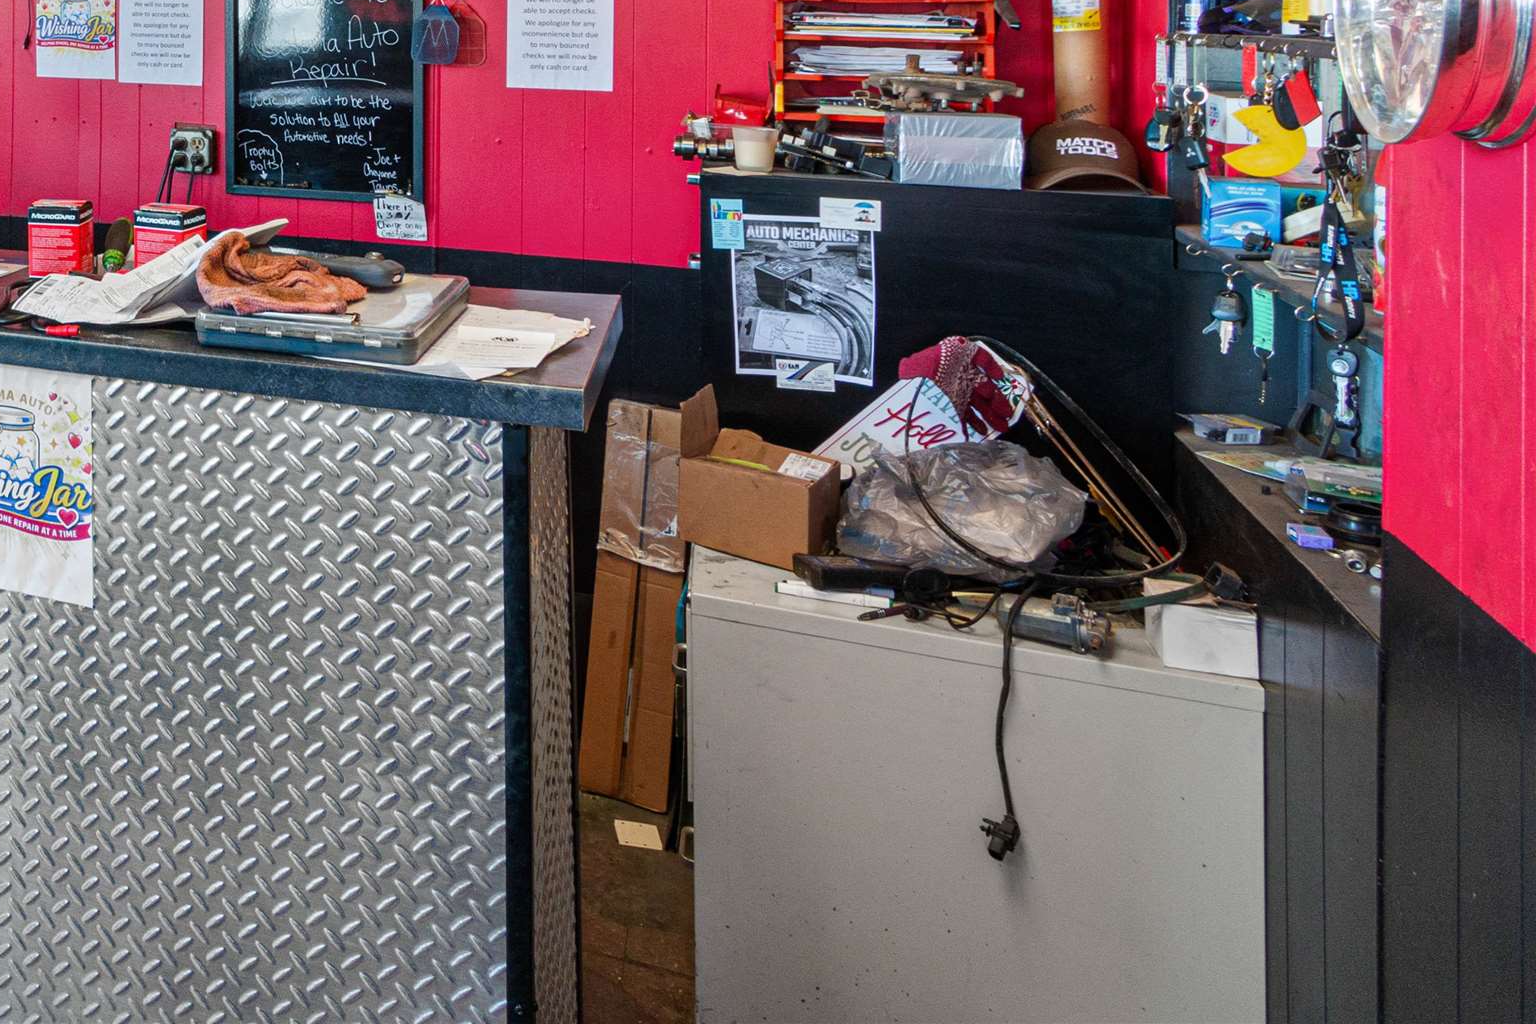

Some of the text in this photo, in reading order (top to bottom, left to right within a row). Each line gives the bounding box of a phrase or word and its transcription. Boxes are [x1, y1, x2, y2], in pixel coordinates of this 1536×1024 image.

[549, 8, 570, 16] accept
[37, 15, 114, 41] Wishing Jar
[348, 15, 400, 50] Auto
[289, 52, 377, 87] Repair!
[334, 97, 348, 106] to
[352, 95, 366, 109] be
[370, 94, 392, 110] the
[270, 111, 316, 126] solution
[318, 114, 331, 127] to
[352, 115, 380, 128] your
[284, 130, 373, 146] Automotive needs!
[1056, 137, 1116, 151] MATCO
[239, 140, 276, 159] Trophy
[1056, 146, 1119, 159] TOOLS
[250, 160, 280, 171] Bolts
[31, 213, 76, 221] MicroGard
[136, 216, 181, 226] MicroGard
[746, 226, 859, 242] AUTO MECHANICS
[787, 241, 816, 249] CENTER
[20, 393, 54, 416] AUTO
[30, 467, 92, 518] Jar
[13, 518, 40, 533] REPAIR
[40, 526, 51, 537] AT
[52, 529, 58, 537] A
[59, 529, 77, 538] TIME
